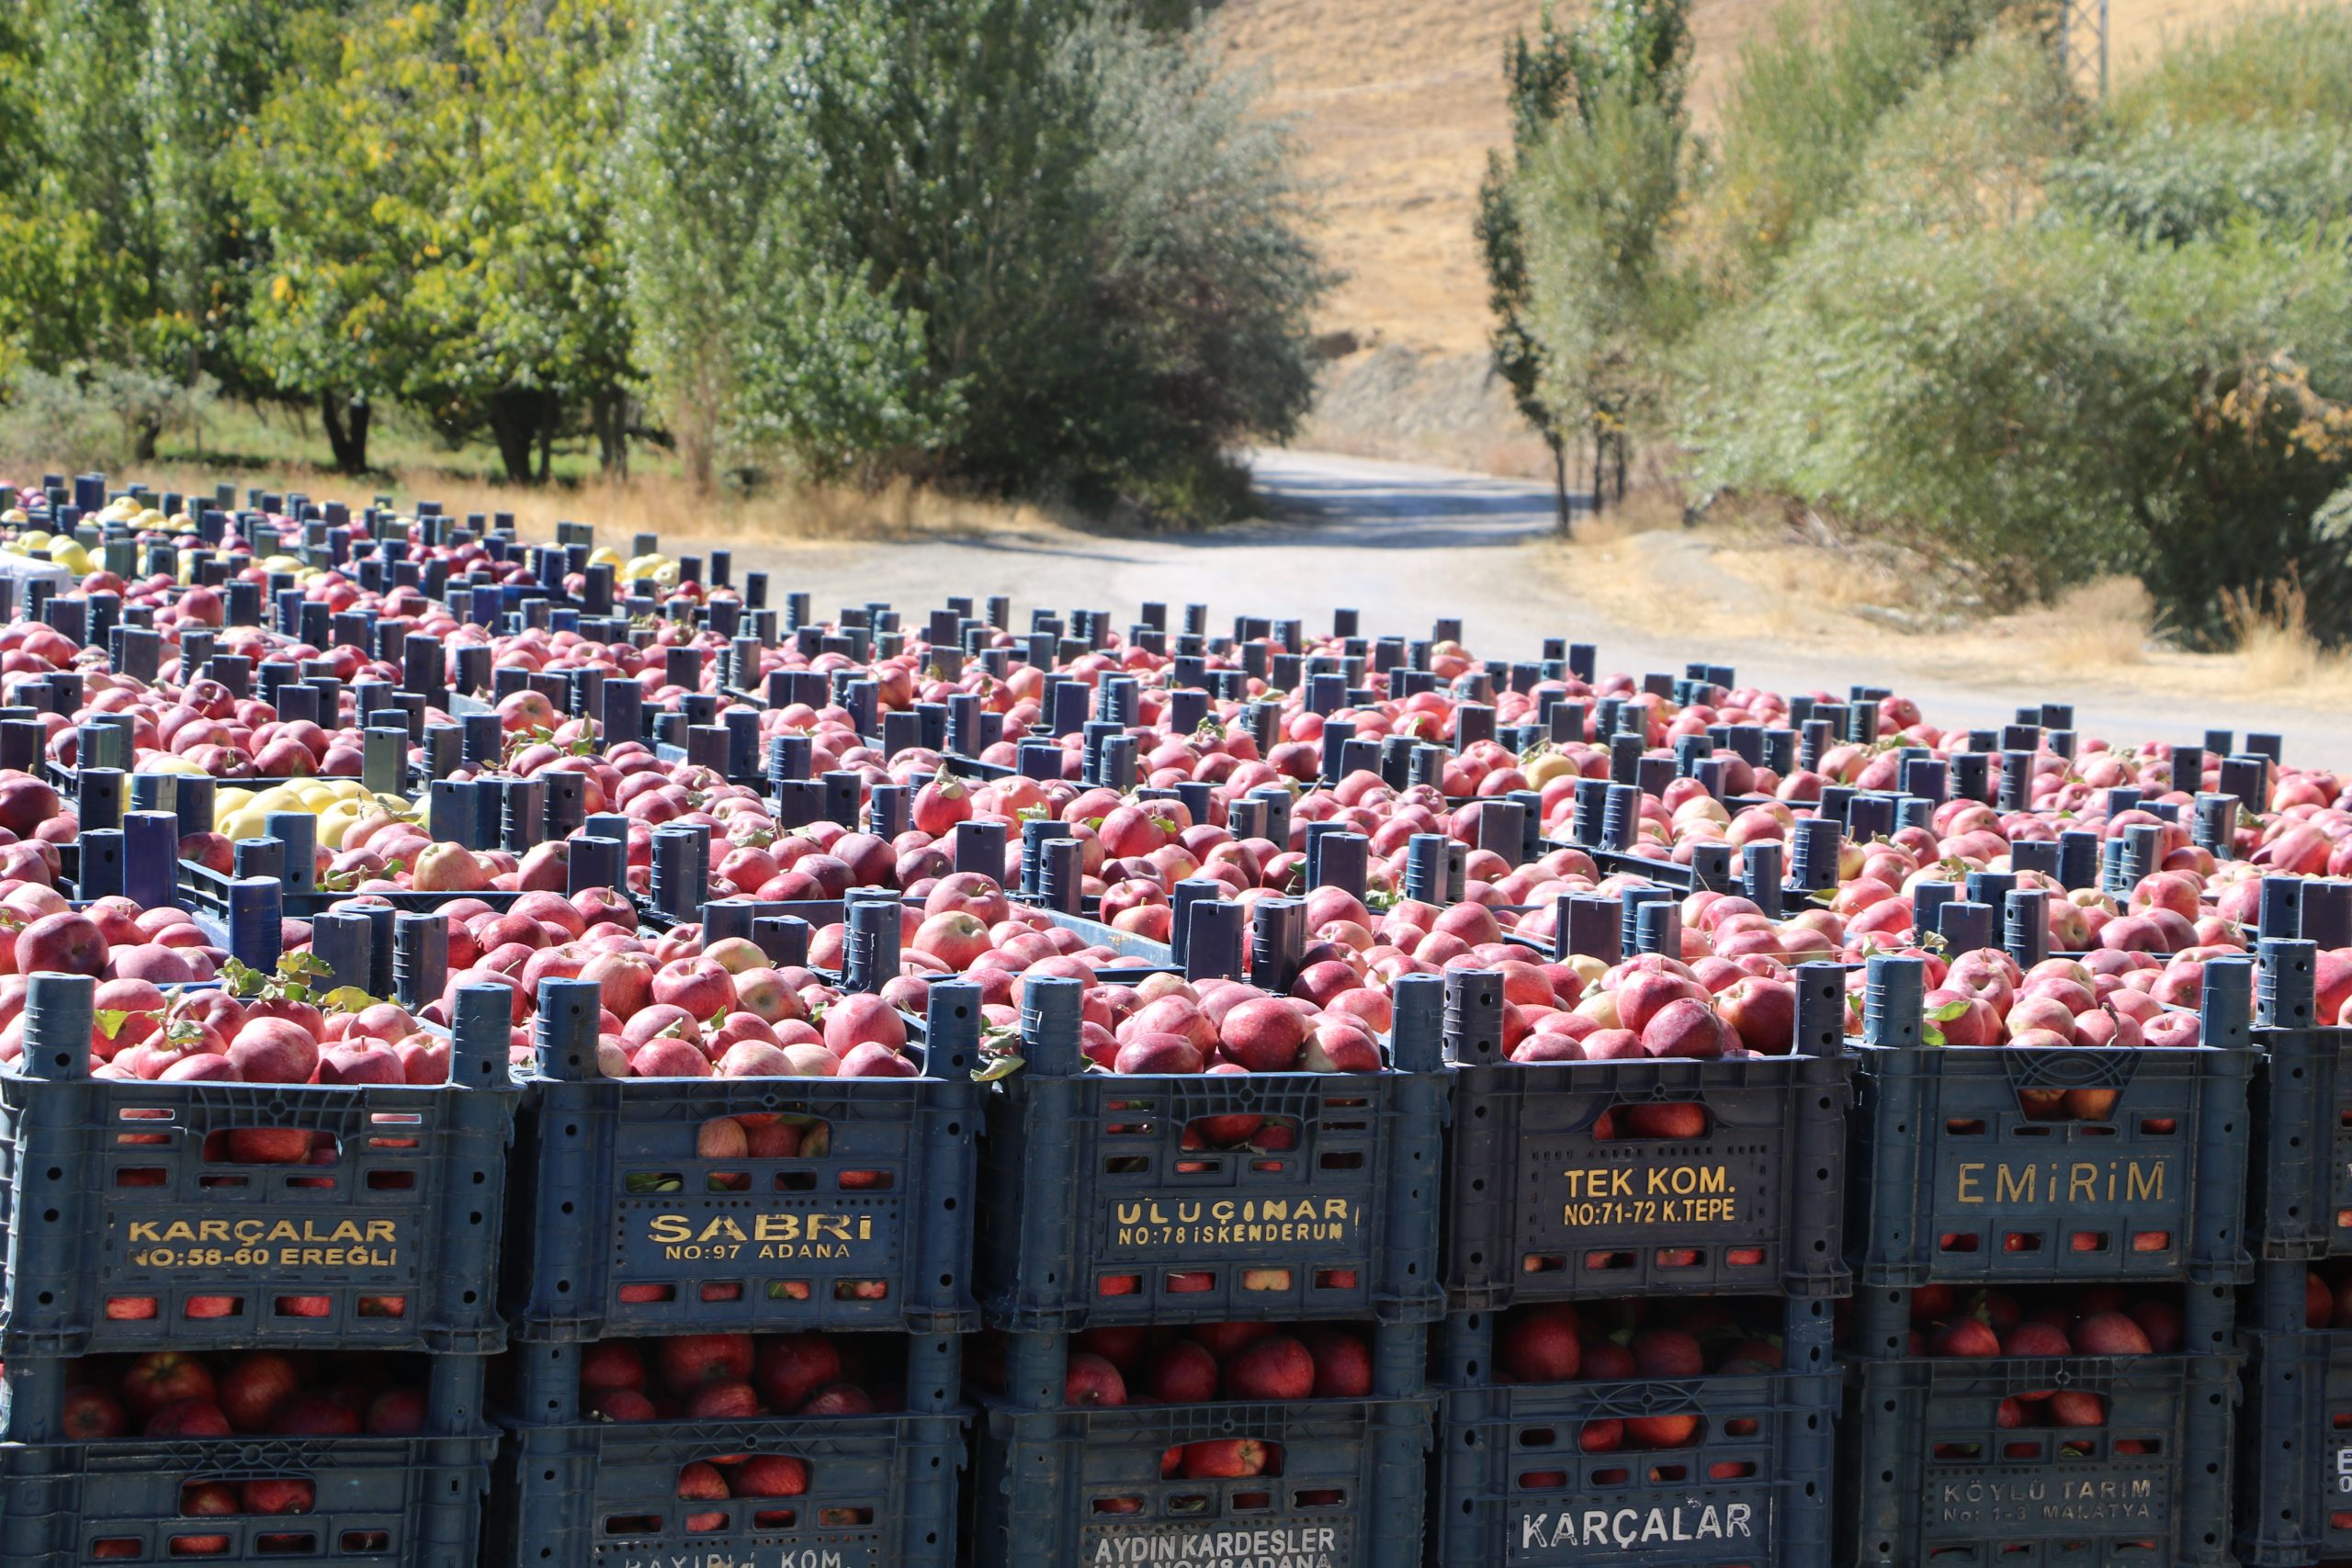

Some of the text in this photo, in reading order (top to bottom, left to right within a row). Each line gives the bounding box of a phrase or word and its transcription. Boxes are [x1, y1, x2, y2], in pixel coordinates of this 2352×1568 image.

[1564, 1166, 1736, 1198] TEK KOM.
[1117, 1198, 1348, 1224] ULUÇINAR
[1564, 1198, 1736, 1226] NO:71-72 K.TEPE
[128, 1219, 397, 1247] KARÇALAR
[1118, 1227, 1185, 1245] NO:78
[127, 1248, 269, 1267] NO:58-60
[665, 1244, 851, 1260] NO:97 ADANA
[1944, 1479, 2151, 1503] KÖYLÜ TARIM
[2043, 1503, 2149, 1520] MALATYA
[1522, 1503, 1751, 1550] KARÇALAR
[1094, 1535, 1176, 1562] AYDIN
